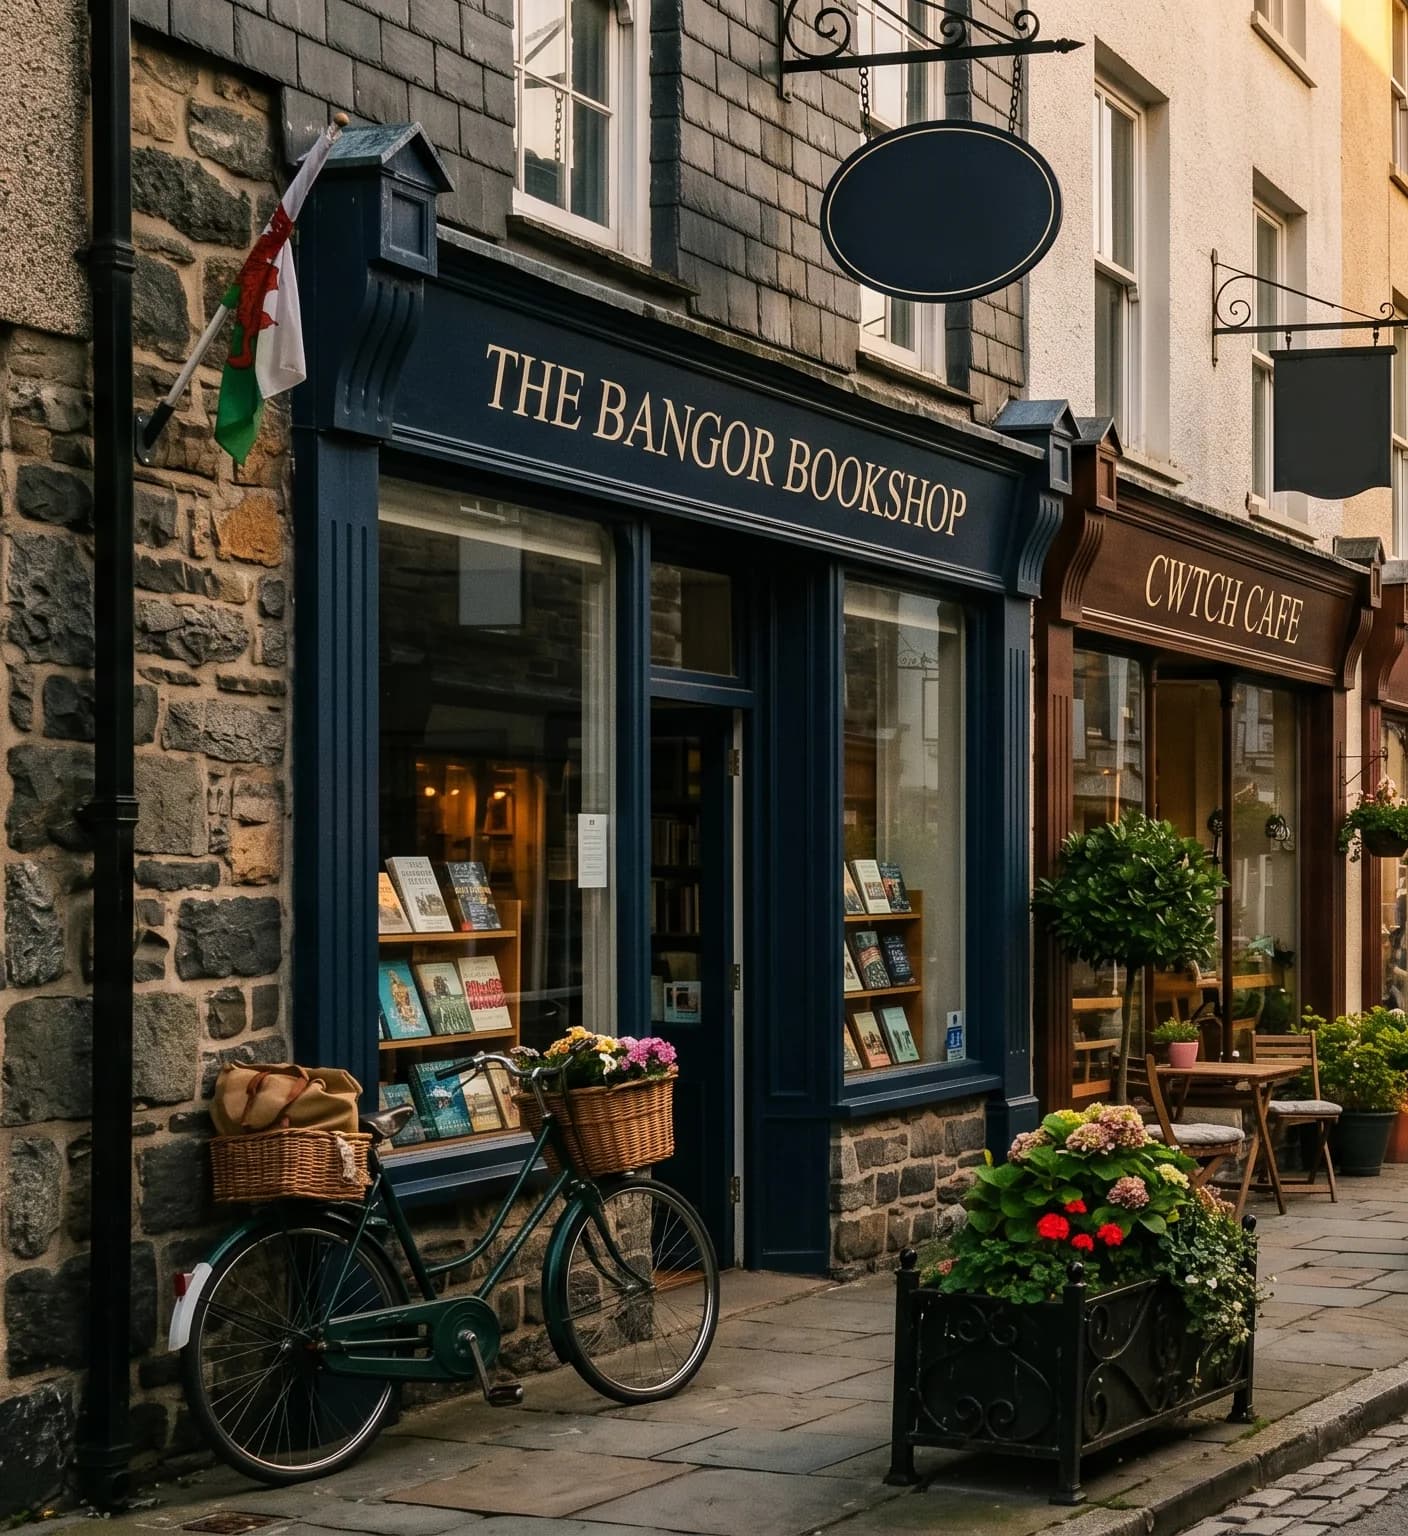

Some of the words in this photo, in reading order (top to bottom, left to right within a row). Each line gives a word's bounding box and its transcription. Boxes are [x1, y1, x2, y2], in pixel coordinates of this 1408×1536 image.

[486, 343, 585, 431] THE
[593, 379, 775, 487] BANGOR
[782, 438, 967, 537] BOOKSHOP
[1145, 554, 1243, 628] CWTCH
[1244, 584, 1304, 645] CAFE
